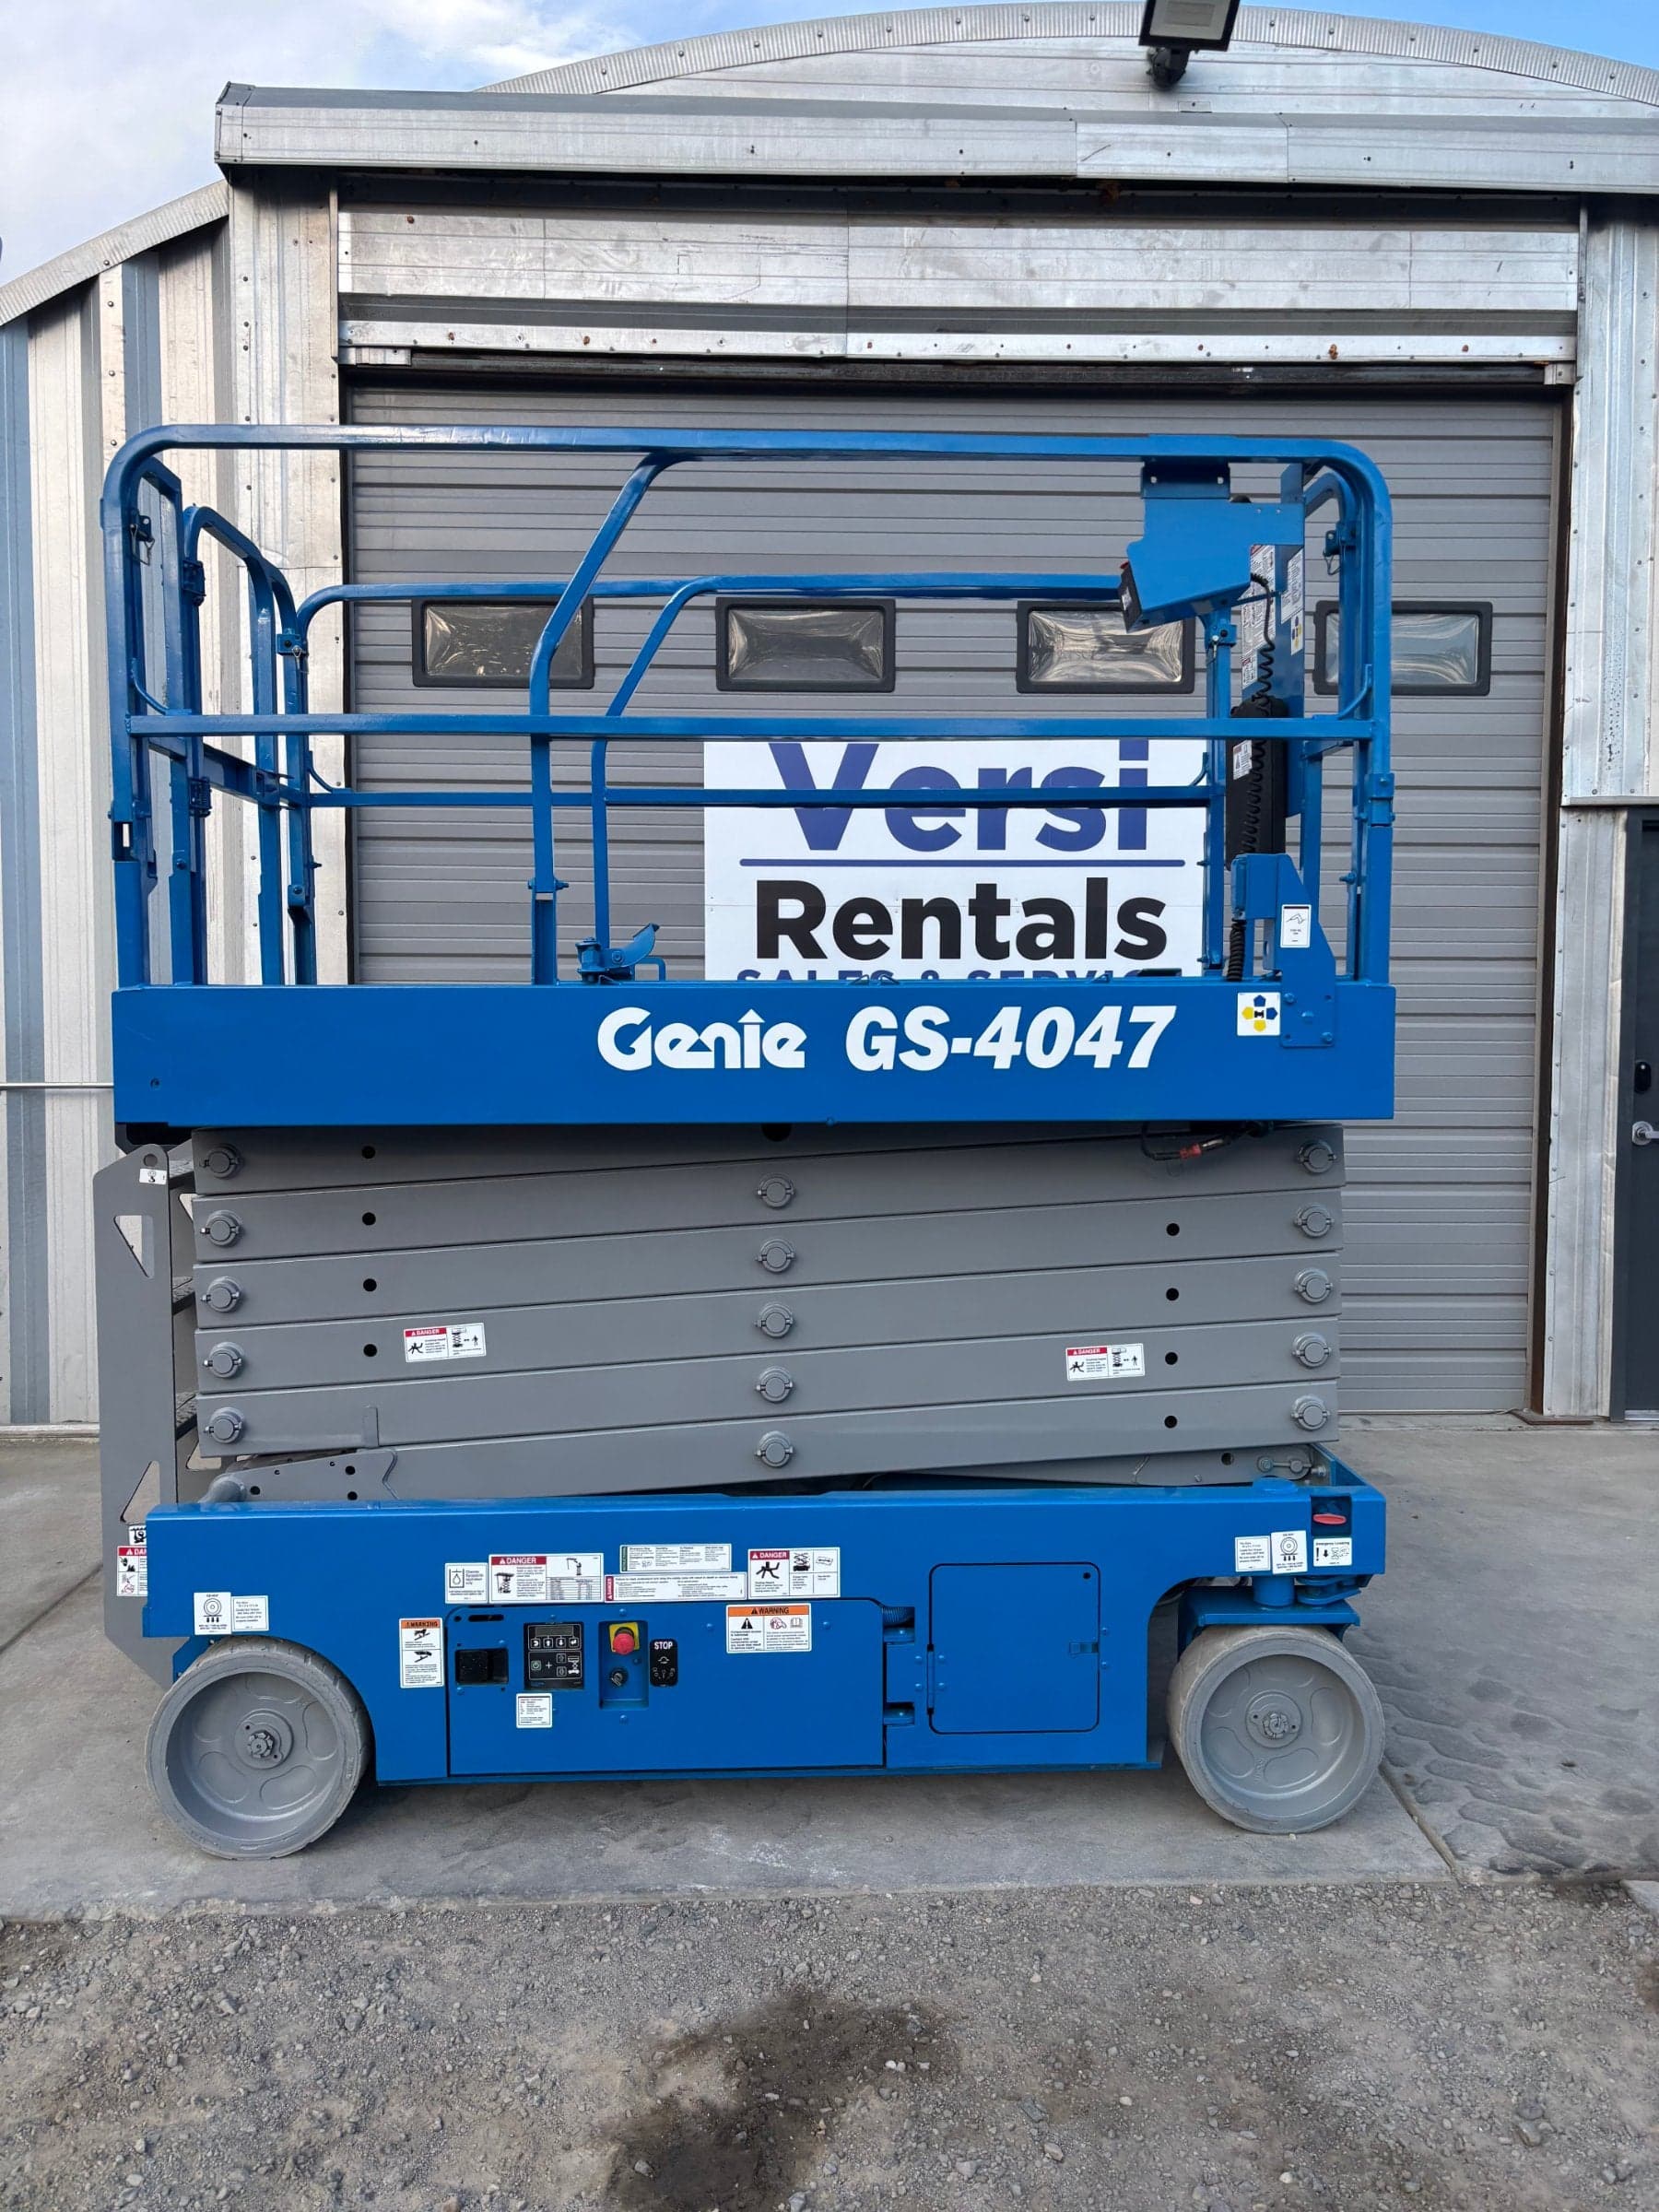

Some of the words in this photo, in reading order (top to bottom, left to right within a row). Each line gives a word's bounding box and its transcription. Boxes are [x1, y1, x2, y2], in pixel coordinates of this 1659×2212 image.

[769, 740, 1148, 852] Versi
[757, 877, 1168, 960] Rentals
[597, 1006, 807, 1071] Genie
[845, 1006, 1177, 1072] GS-4047
[759, 1550, 787, 1559] DANGER
[653, 1641, 674, 1650] STOP
